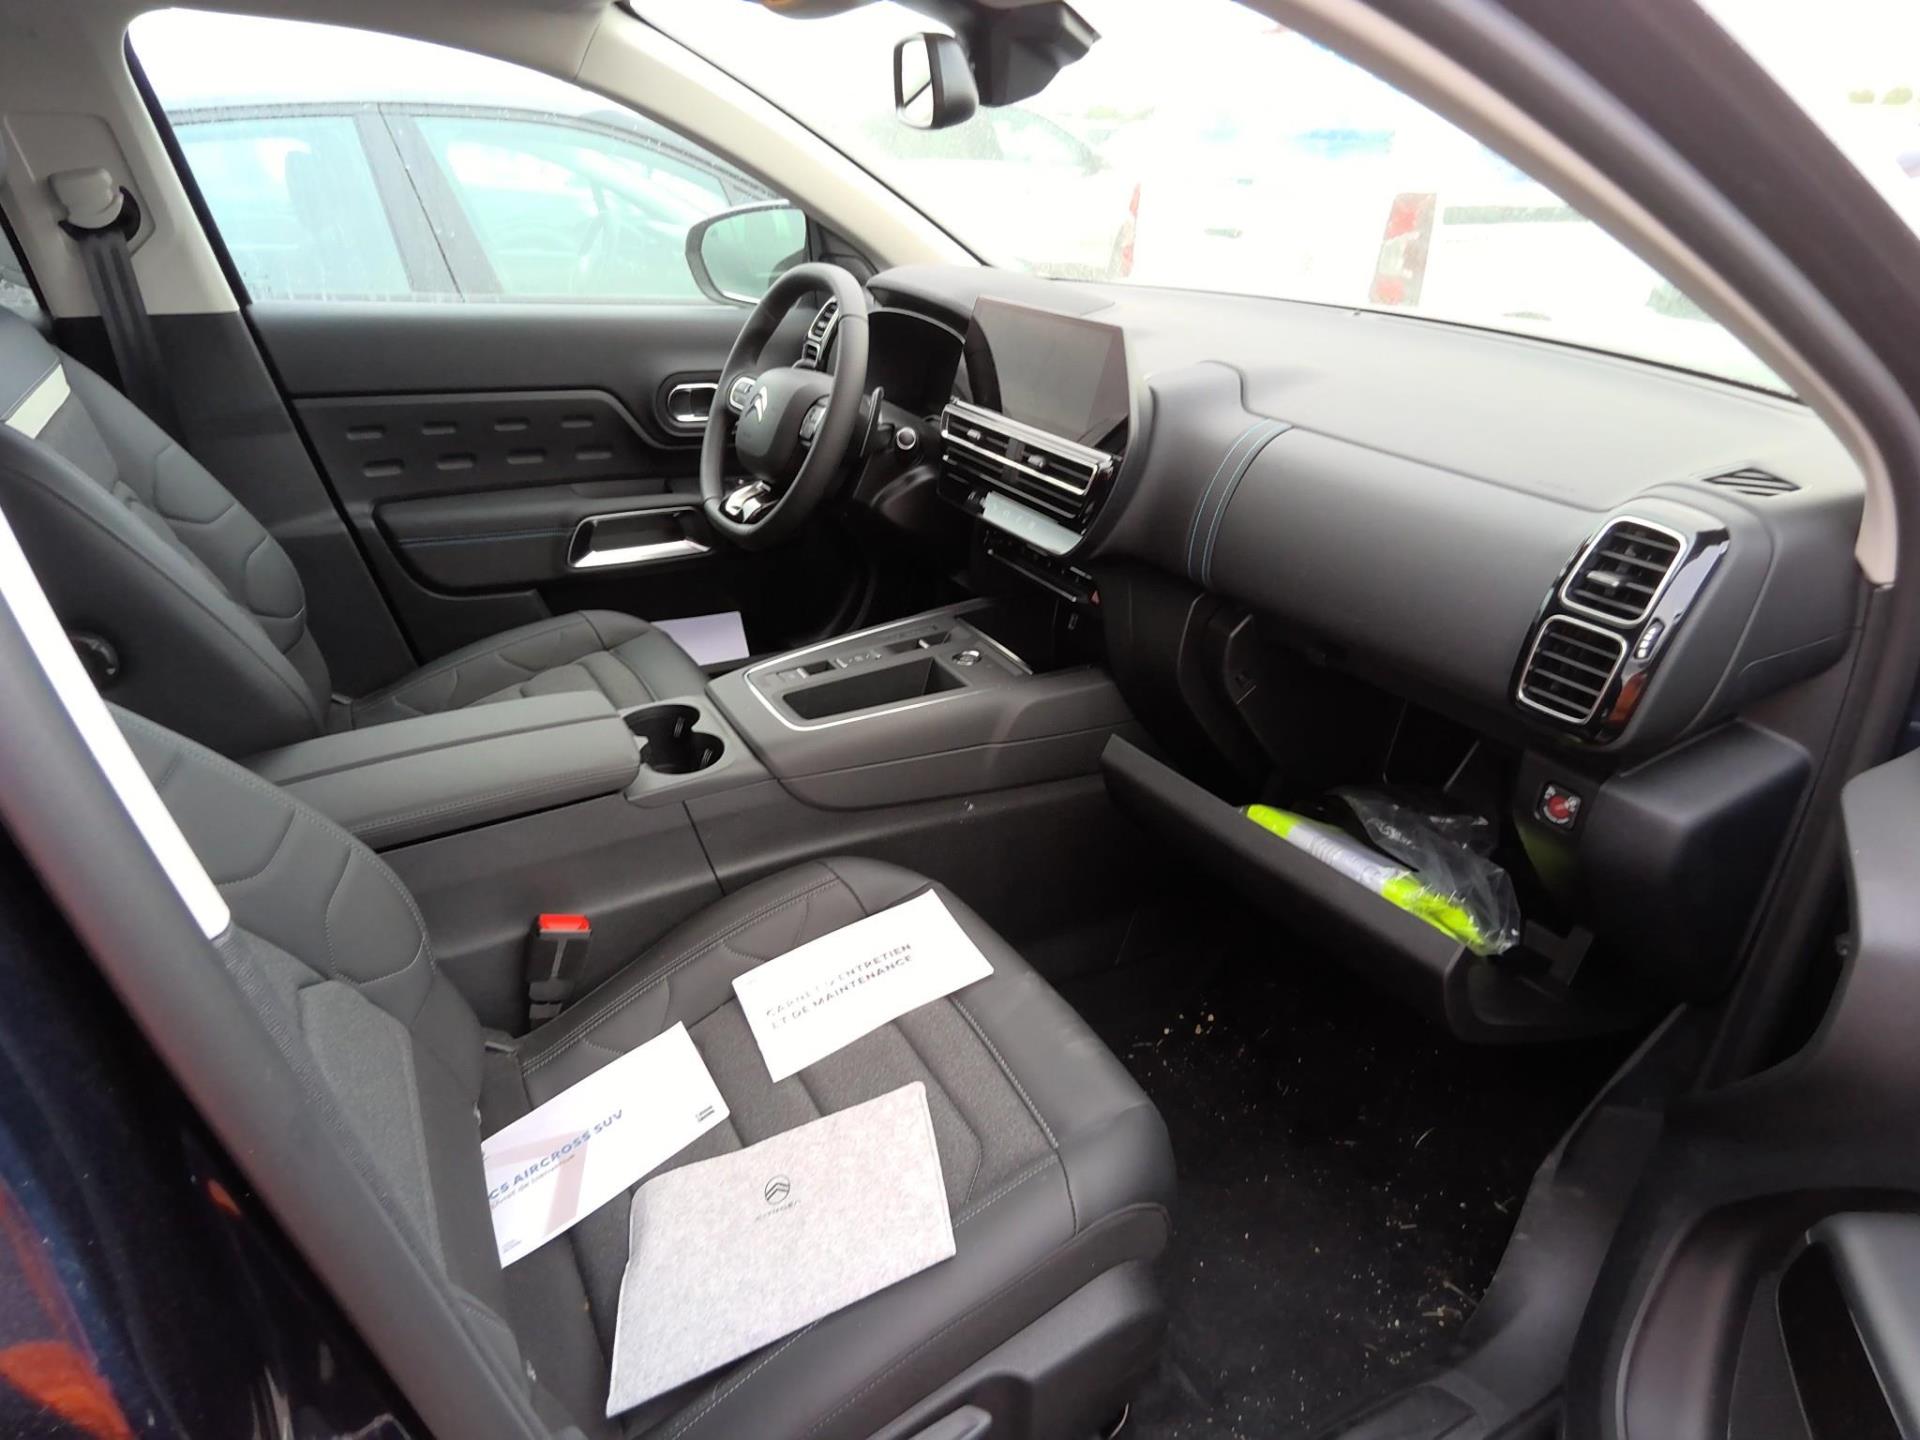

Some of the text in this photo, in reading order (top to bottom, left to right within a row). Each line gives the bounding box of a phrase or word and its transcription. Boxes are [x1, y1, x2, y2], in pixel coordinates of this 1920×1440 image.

[813, 954, 913, 1008] MAINTENANCE
[513, 1130, 592, 1186] AIRCROSS
[593, 1108, 623, 1135] SUV
